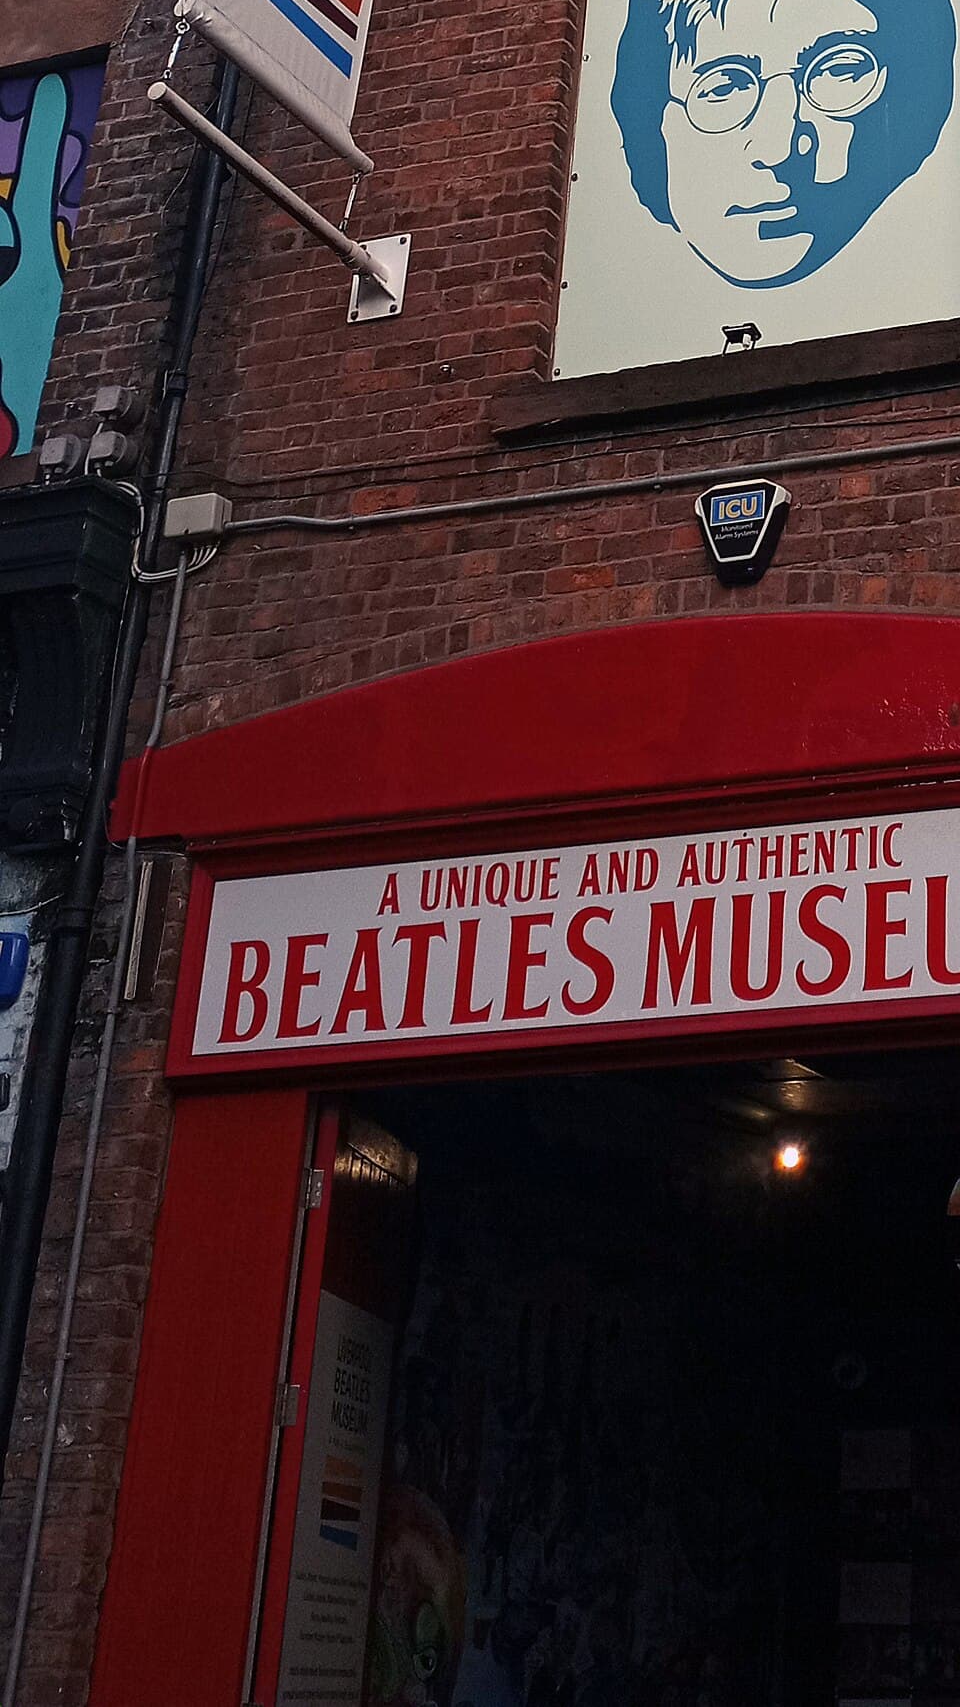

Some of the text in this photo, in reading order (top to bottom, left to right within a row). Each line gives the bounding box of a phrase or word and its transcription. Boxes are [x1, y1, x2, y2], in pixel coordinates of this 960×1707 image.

[718, 496, 758, 520] ICU
[376, 822, 904, 916] A UNIQUE AND AUTHENTIC
[217, 905, 615, 1045] BEATLES
